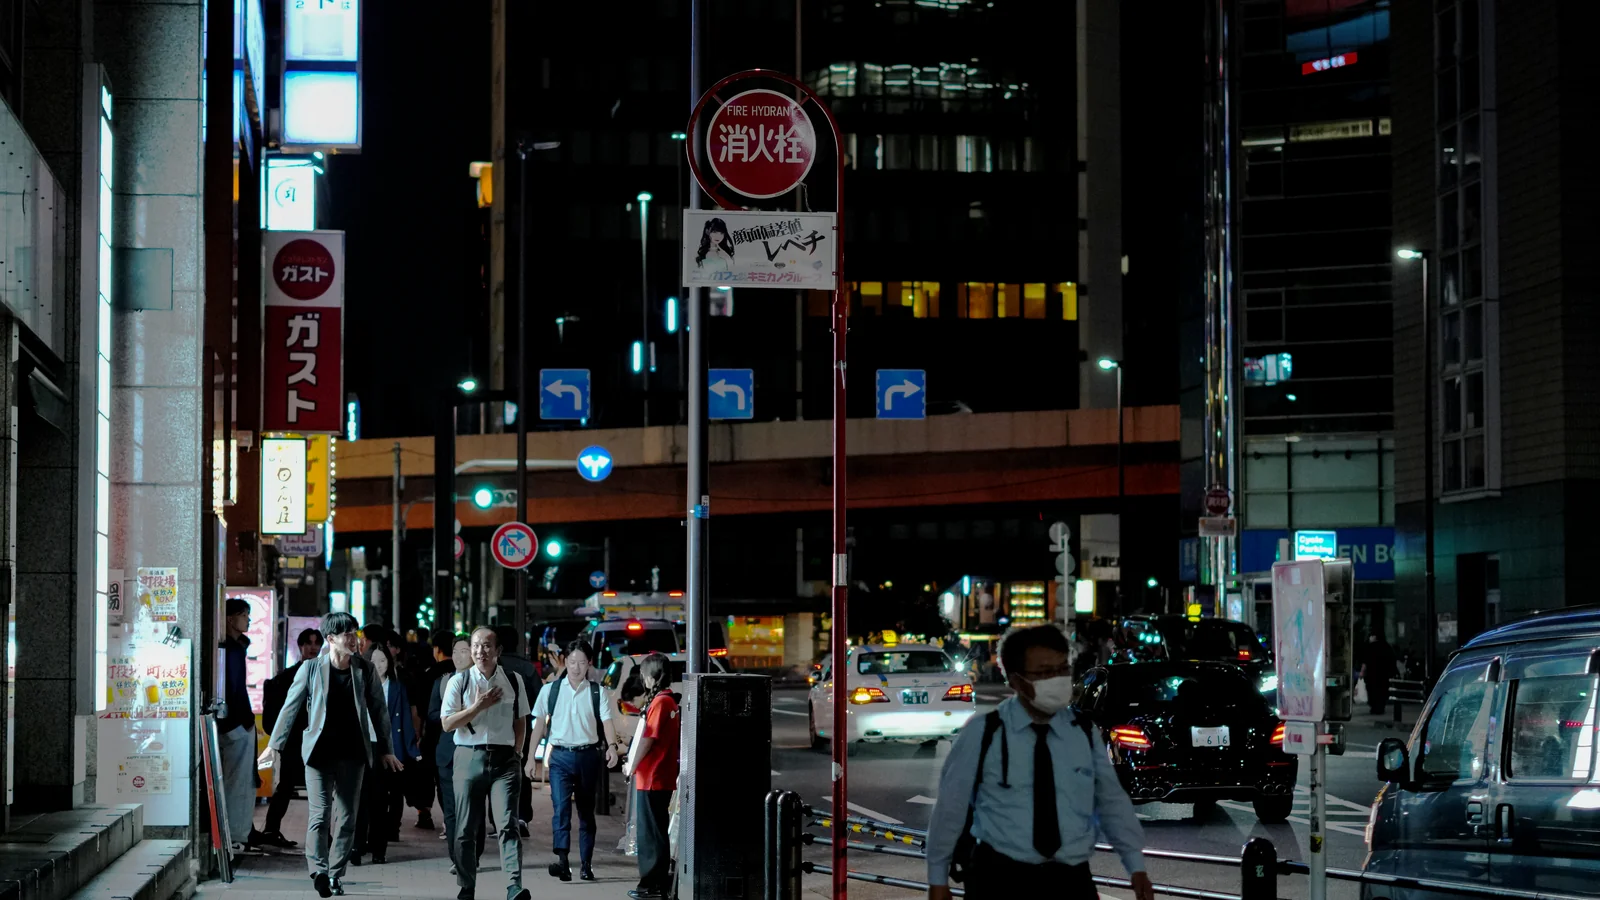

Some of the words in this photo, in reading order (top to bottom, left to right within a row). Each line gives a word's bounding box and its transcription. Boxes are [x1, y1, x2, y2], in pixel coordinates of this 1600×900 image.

[727, 105, 748, 116] FIRE
[751, 105, 797, 117] HYDRANT
[719, 124, 805, 163] 消火栓
[732, 218, 803, 245] 顔面偏差値
[762, 229, 826, 262] レベチ
[281, 265, 329, 283] ガスト
[286, 312, 320, 423] ガスト
[1299, 535, 1324, 545] Cycle
[1299, 545, 1333, 555] Parking
[161, 680, 184, 689] 昼飲み
[168, 688, 186, 696] OK!
